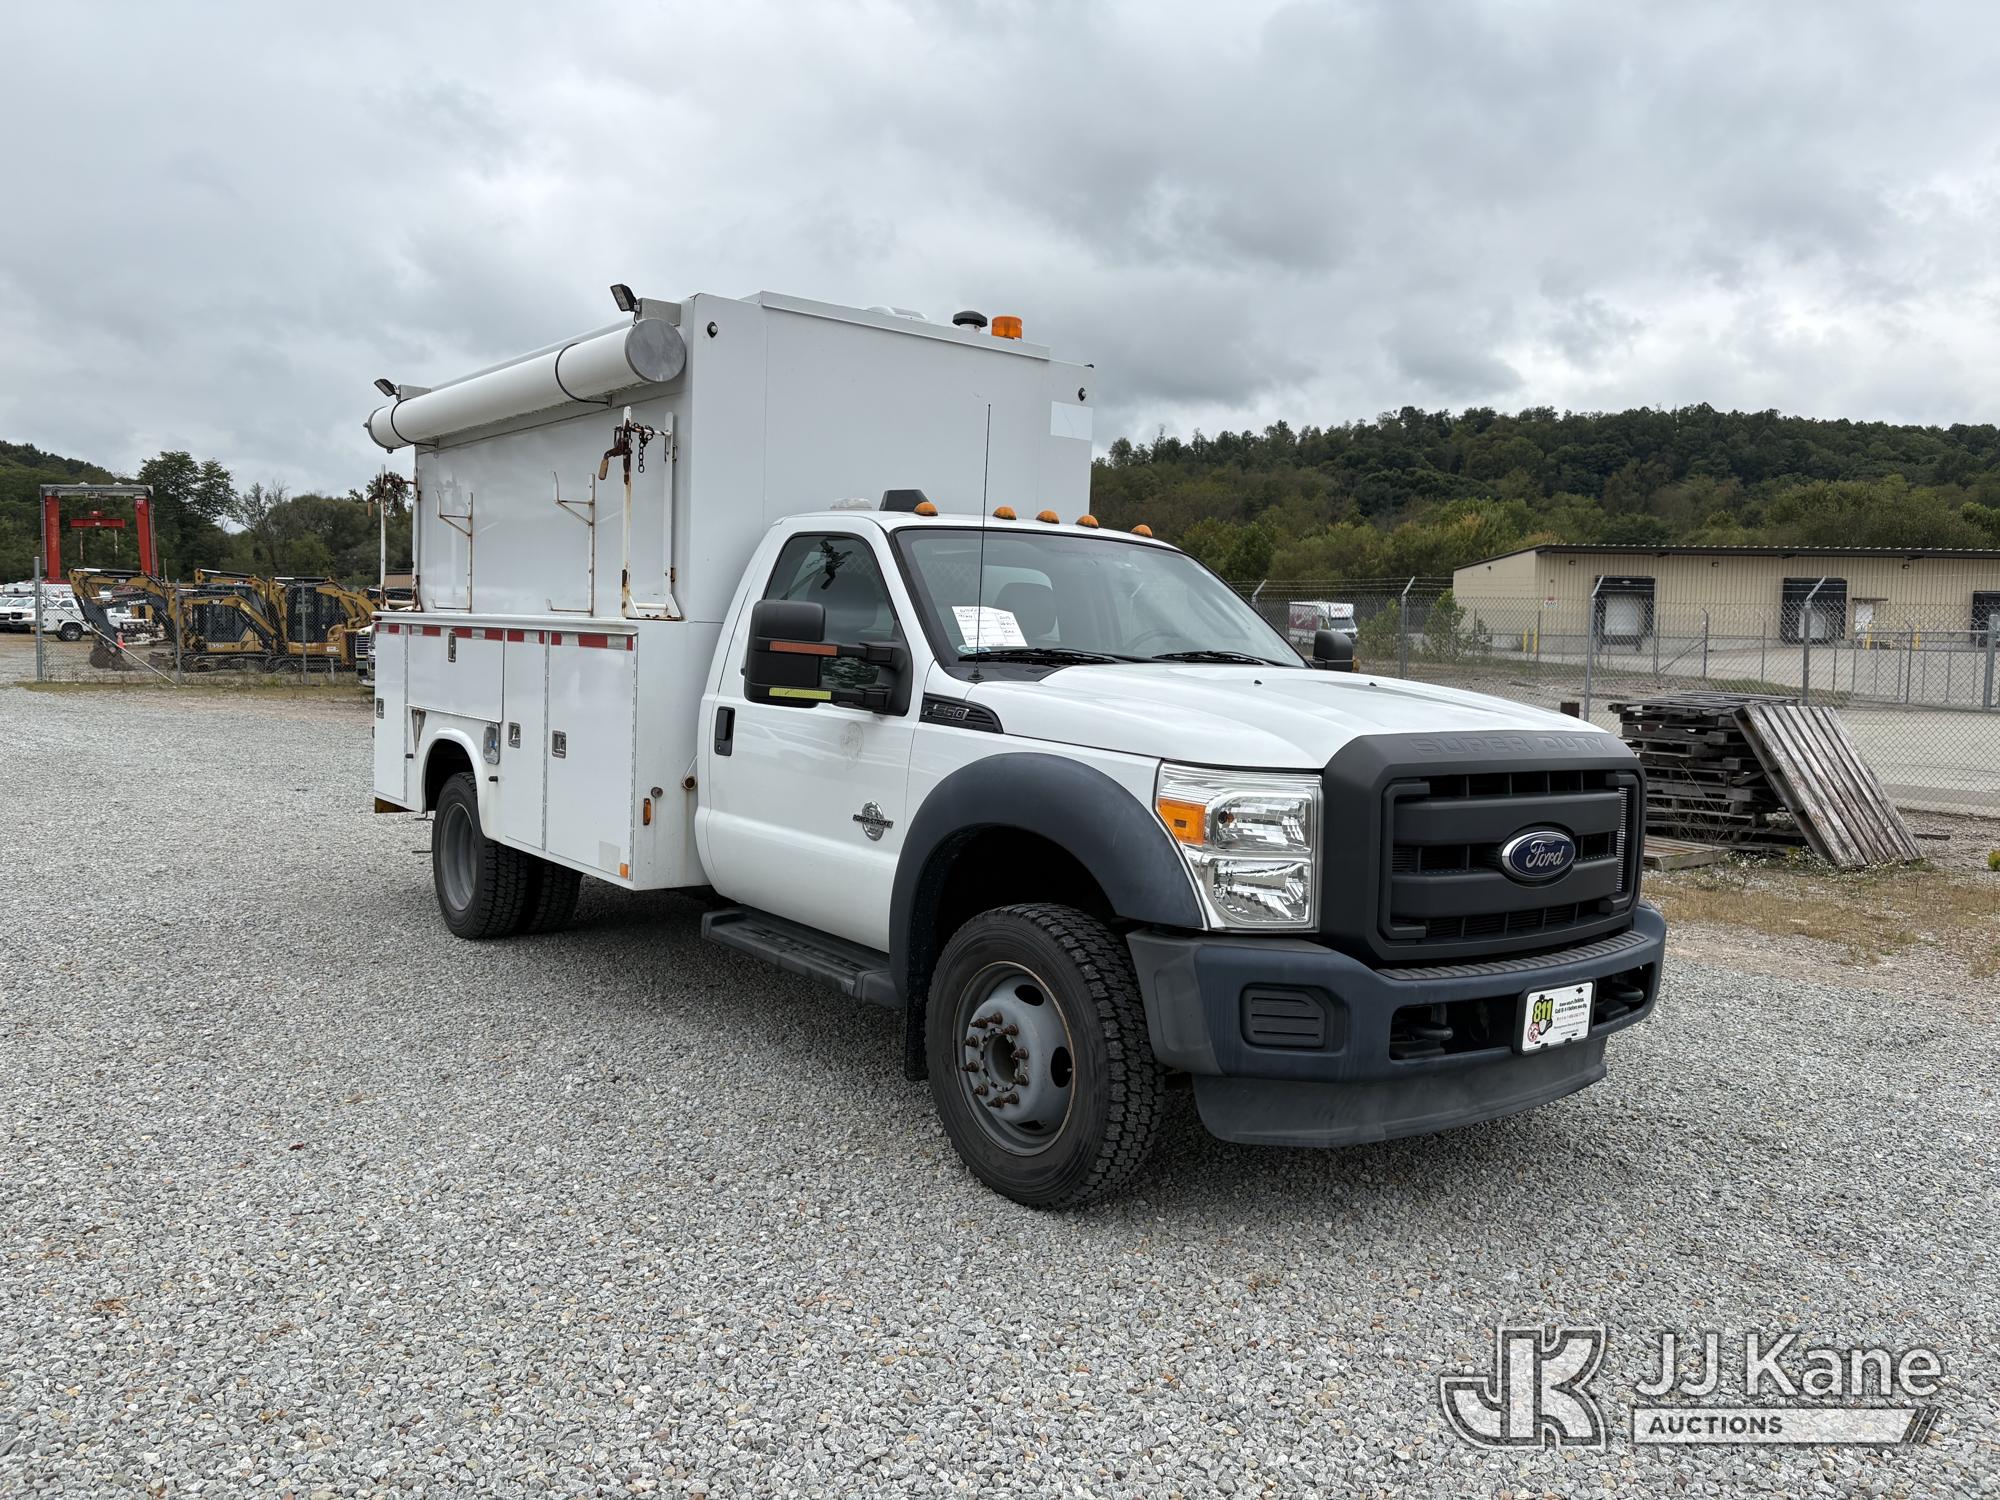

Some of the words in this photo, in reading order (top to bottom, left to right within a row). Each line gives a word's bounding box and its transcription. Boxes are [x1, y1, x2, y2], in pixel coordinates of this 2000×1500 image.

[1408, 736, 1535, 756] SUPER
[1536, 735, 1608, 752] DUTY
[1526, 840, 1565, 868] Ford
[1532, 998, 1554, 1024] 811
